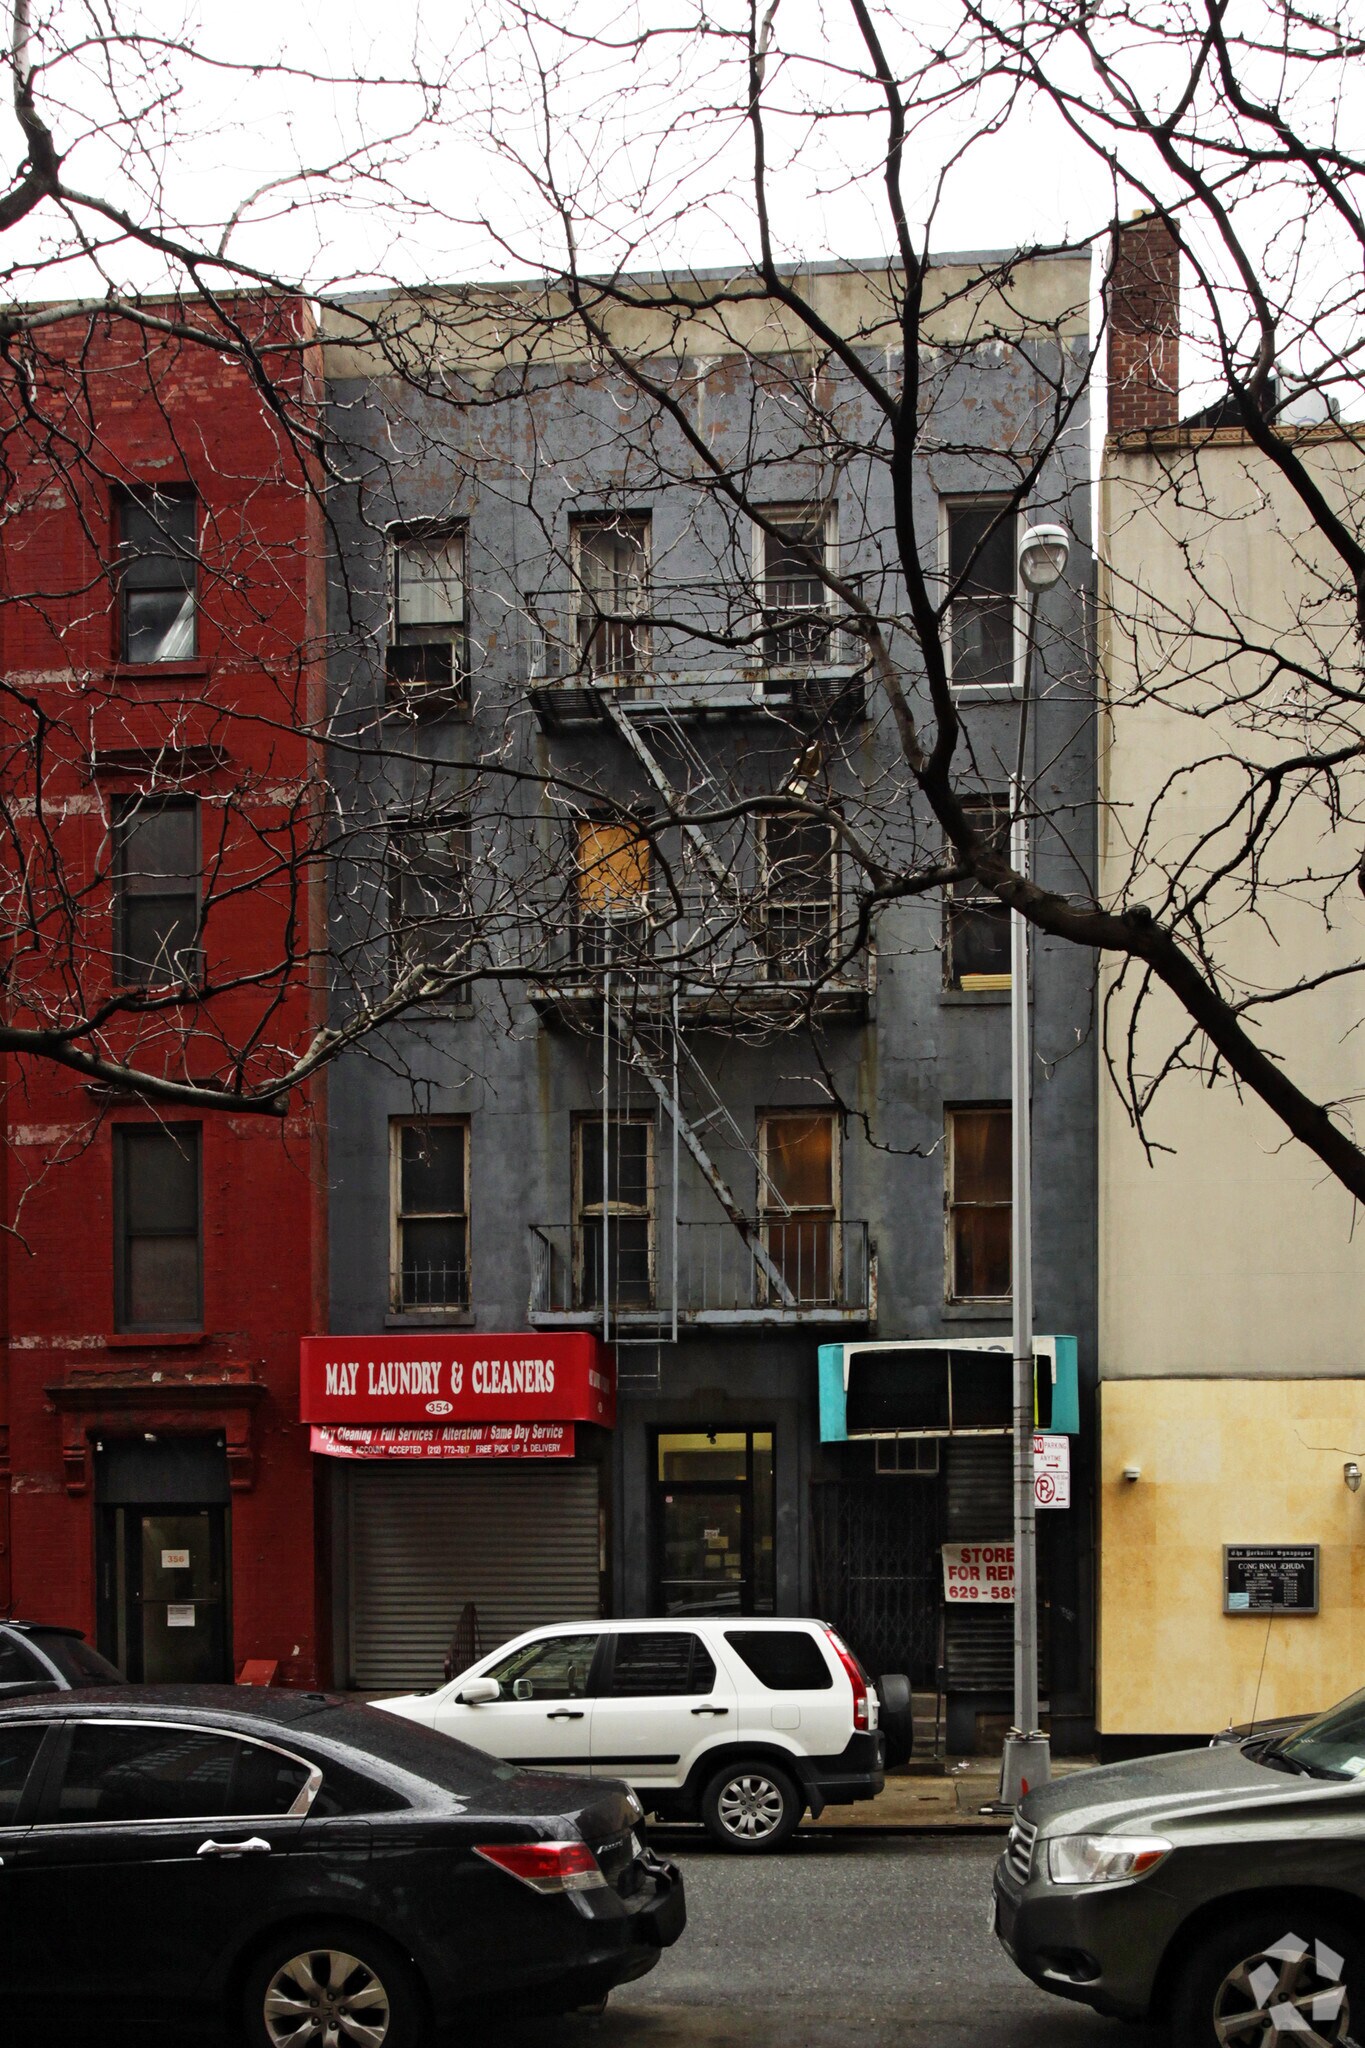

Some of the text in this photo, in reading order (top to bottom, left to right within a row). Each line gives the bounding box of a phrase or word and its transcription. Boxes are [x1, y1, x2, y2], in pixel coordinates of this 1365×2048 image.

[325, 1362, 359, 1395] MAY
[368, 1361, 442, 1395] LAUNDRY
[451, 1361, 463, 1394] &
[472, 1359, 555, 1394] CLEANERS
[428, 1403, 450, 1412] 354
[320, 1426, 335, 1443] Dry
[337, 1426, 372, 1444] Cleaning
[381, 1427, 396, 1441] Full
[398, 1427, 433, 1441] Services
[442, 1426, 483, 1441] Alteration
[490, 1425, 512, 1439] Same
[514, 1424, 530, 1442] Day
[532, 1424, 563, 1439] Service
[326, 1444, 353, 1454] CHARGE
[355, 1445, 386, 1454] ACCOUNT
[388, 1445, 422, 1454] ACCEPTED
[427, 1446, 442, 1455] (212)
[475, 1444, 492, 1453] FREE
[494, 1444, 509, 1453] PICK
[511, 1444, 521, 1453] UP
[530, 1443, 561, 1453] DELIVERY
[1033, 1438, 1067, 1451] NO PARKING
[960, 1547, 1014, 1563] STORE
[948, 1566, 1015, 1580] FOR REN
